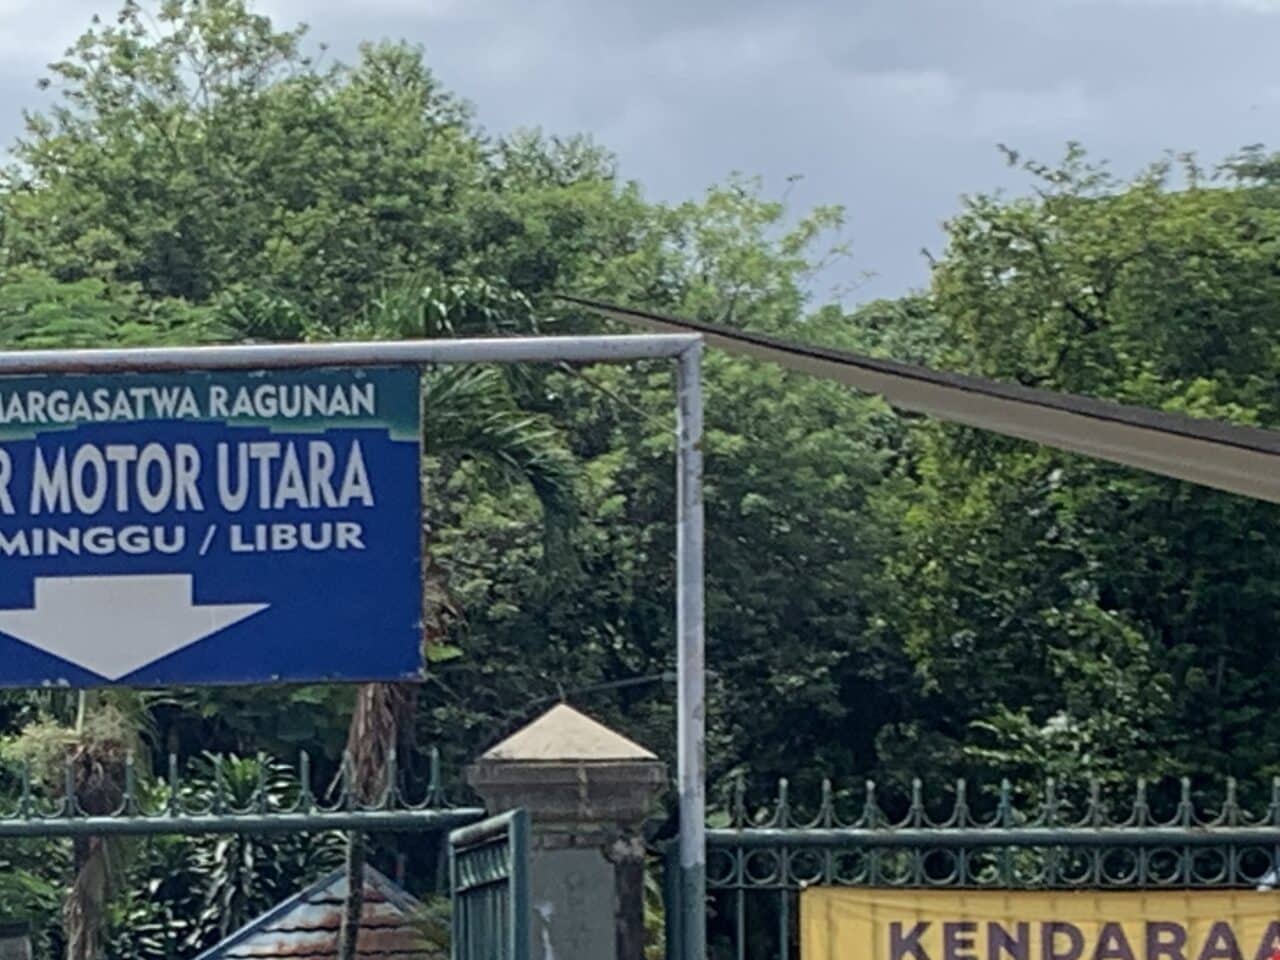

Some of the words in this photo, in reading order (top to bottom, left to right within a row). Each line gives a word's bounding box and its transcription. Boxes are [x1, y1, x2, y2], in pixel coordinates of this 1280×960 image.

[209, 382, 375, 418] RAGUNAN
[30, 442, 202, 515] MOTOR
[217, 439, 375, 510] UTARA
[230, 521, 366, 553] LIBUR
